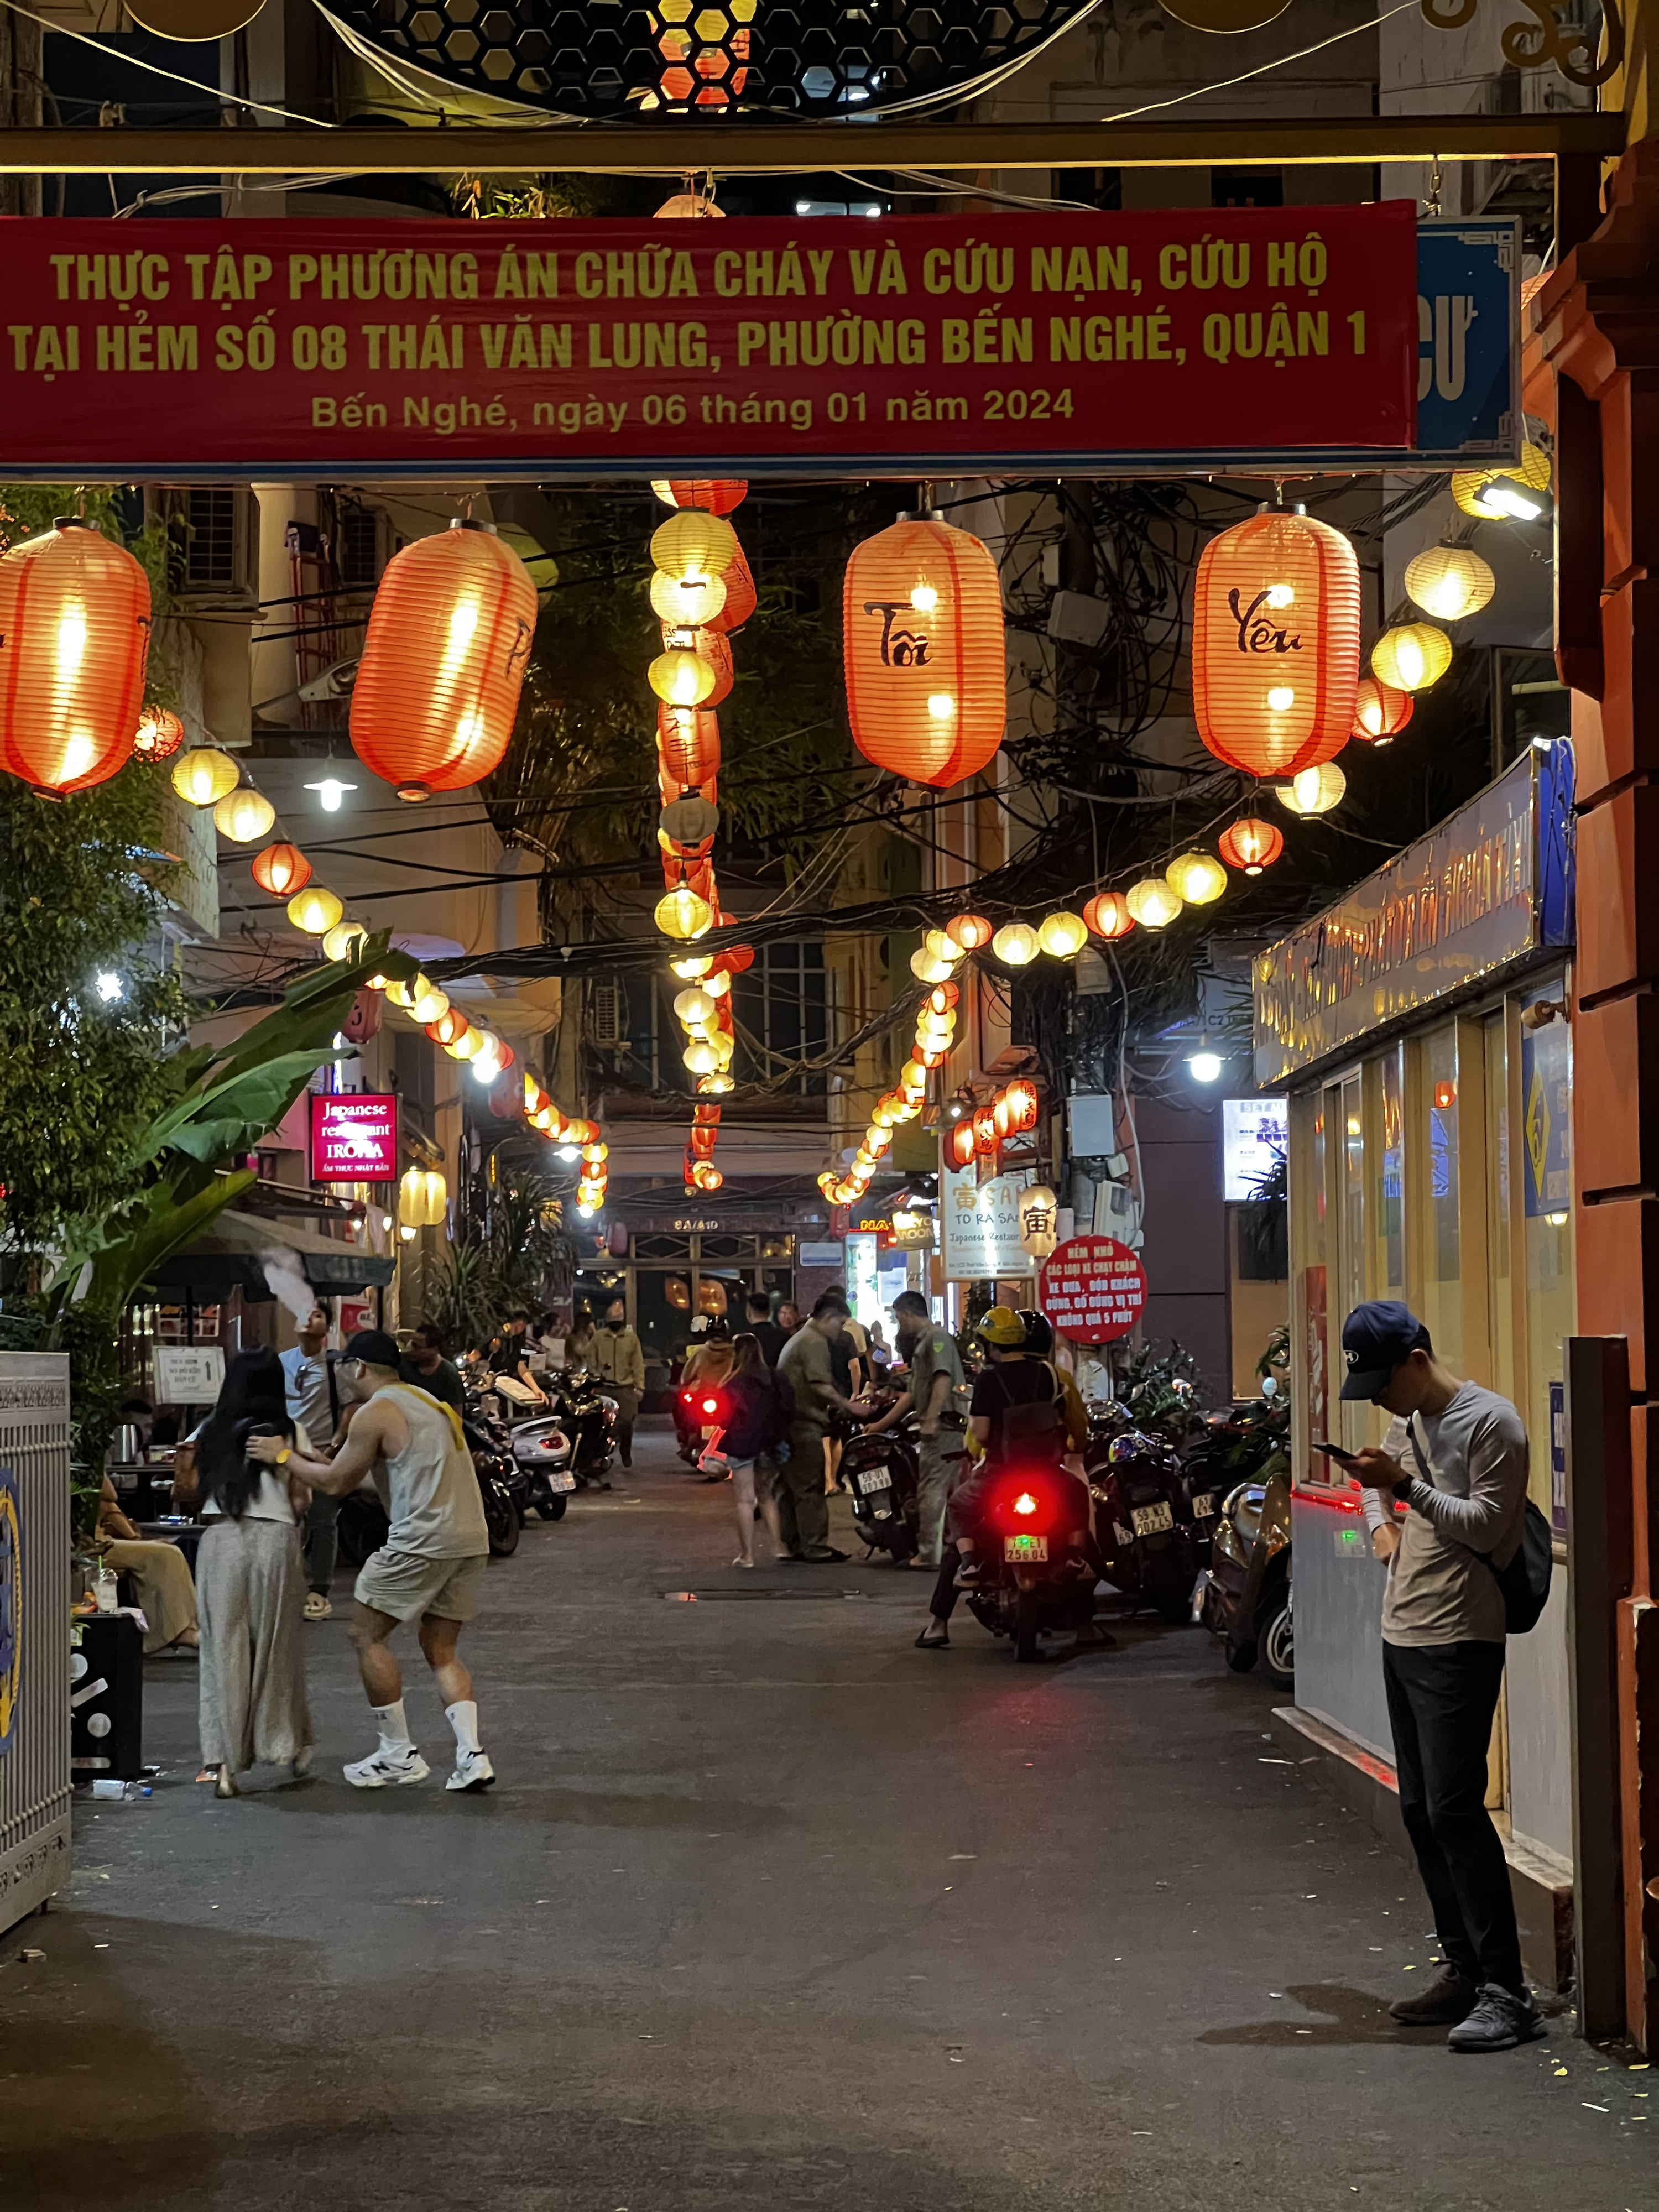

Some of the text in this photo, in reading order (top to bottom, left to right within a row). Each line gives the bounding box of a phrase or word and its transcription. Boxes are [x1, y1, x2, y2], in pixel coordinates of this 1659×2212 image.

[50, 232, 1326, 310] THỰC TẬP PHƯƠNG ÁN CHỮA CHÁY VÀ CỨU NẠN, CỨU HỘ
[8, 303, 1364, 381] TẠI HẺM SỐ 08 THÁI VĂN LUNG, PHƯỜNG BẾN NGHÉ, QUẬN 1
[312, 389, 1073, 434] Bến Nghé, ngày 06 tháng 01 năm 2024
[1228, 587, 1303, 653] Yêu
[322, 1102, 387, 1121] Japanese
[954, 1214, 971, 1224] TO
[976, 1214, 994, 1225] RA
[950, 1233, 985, 1245] Japanese
[1008, 1550, 1045, 1560] 256.04
